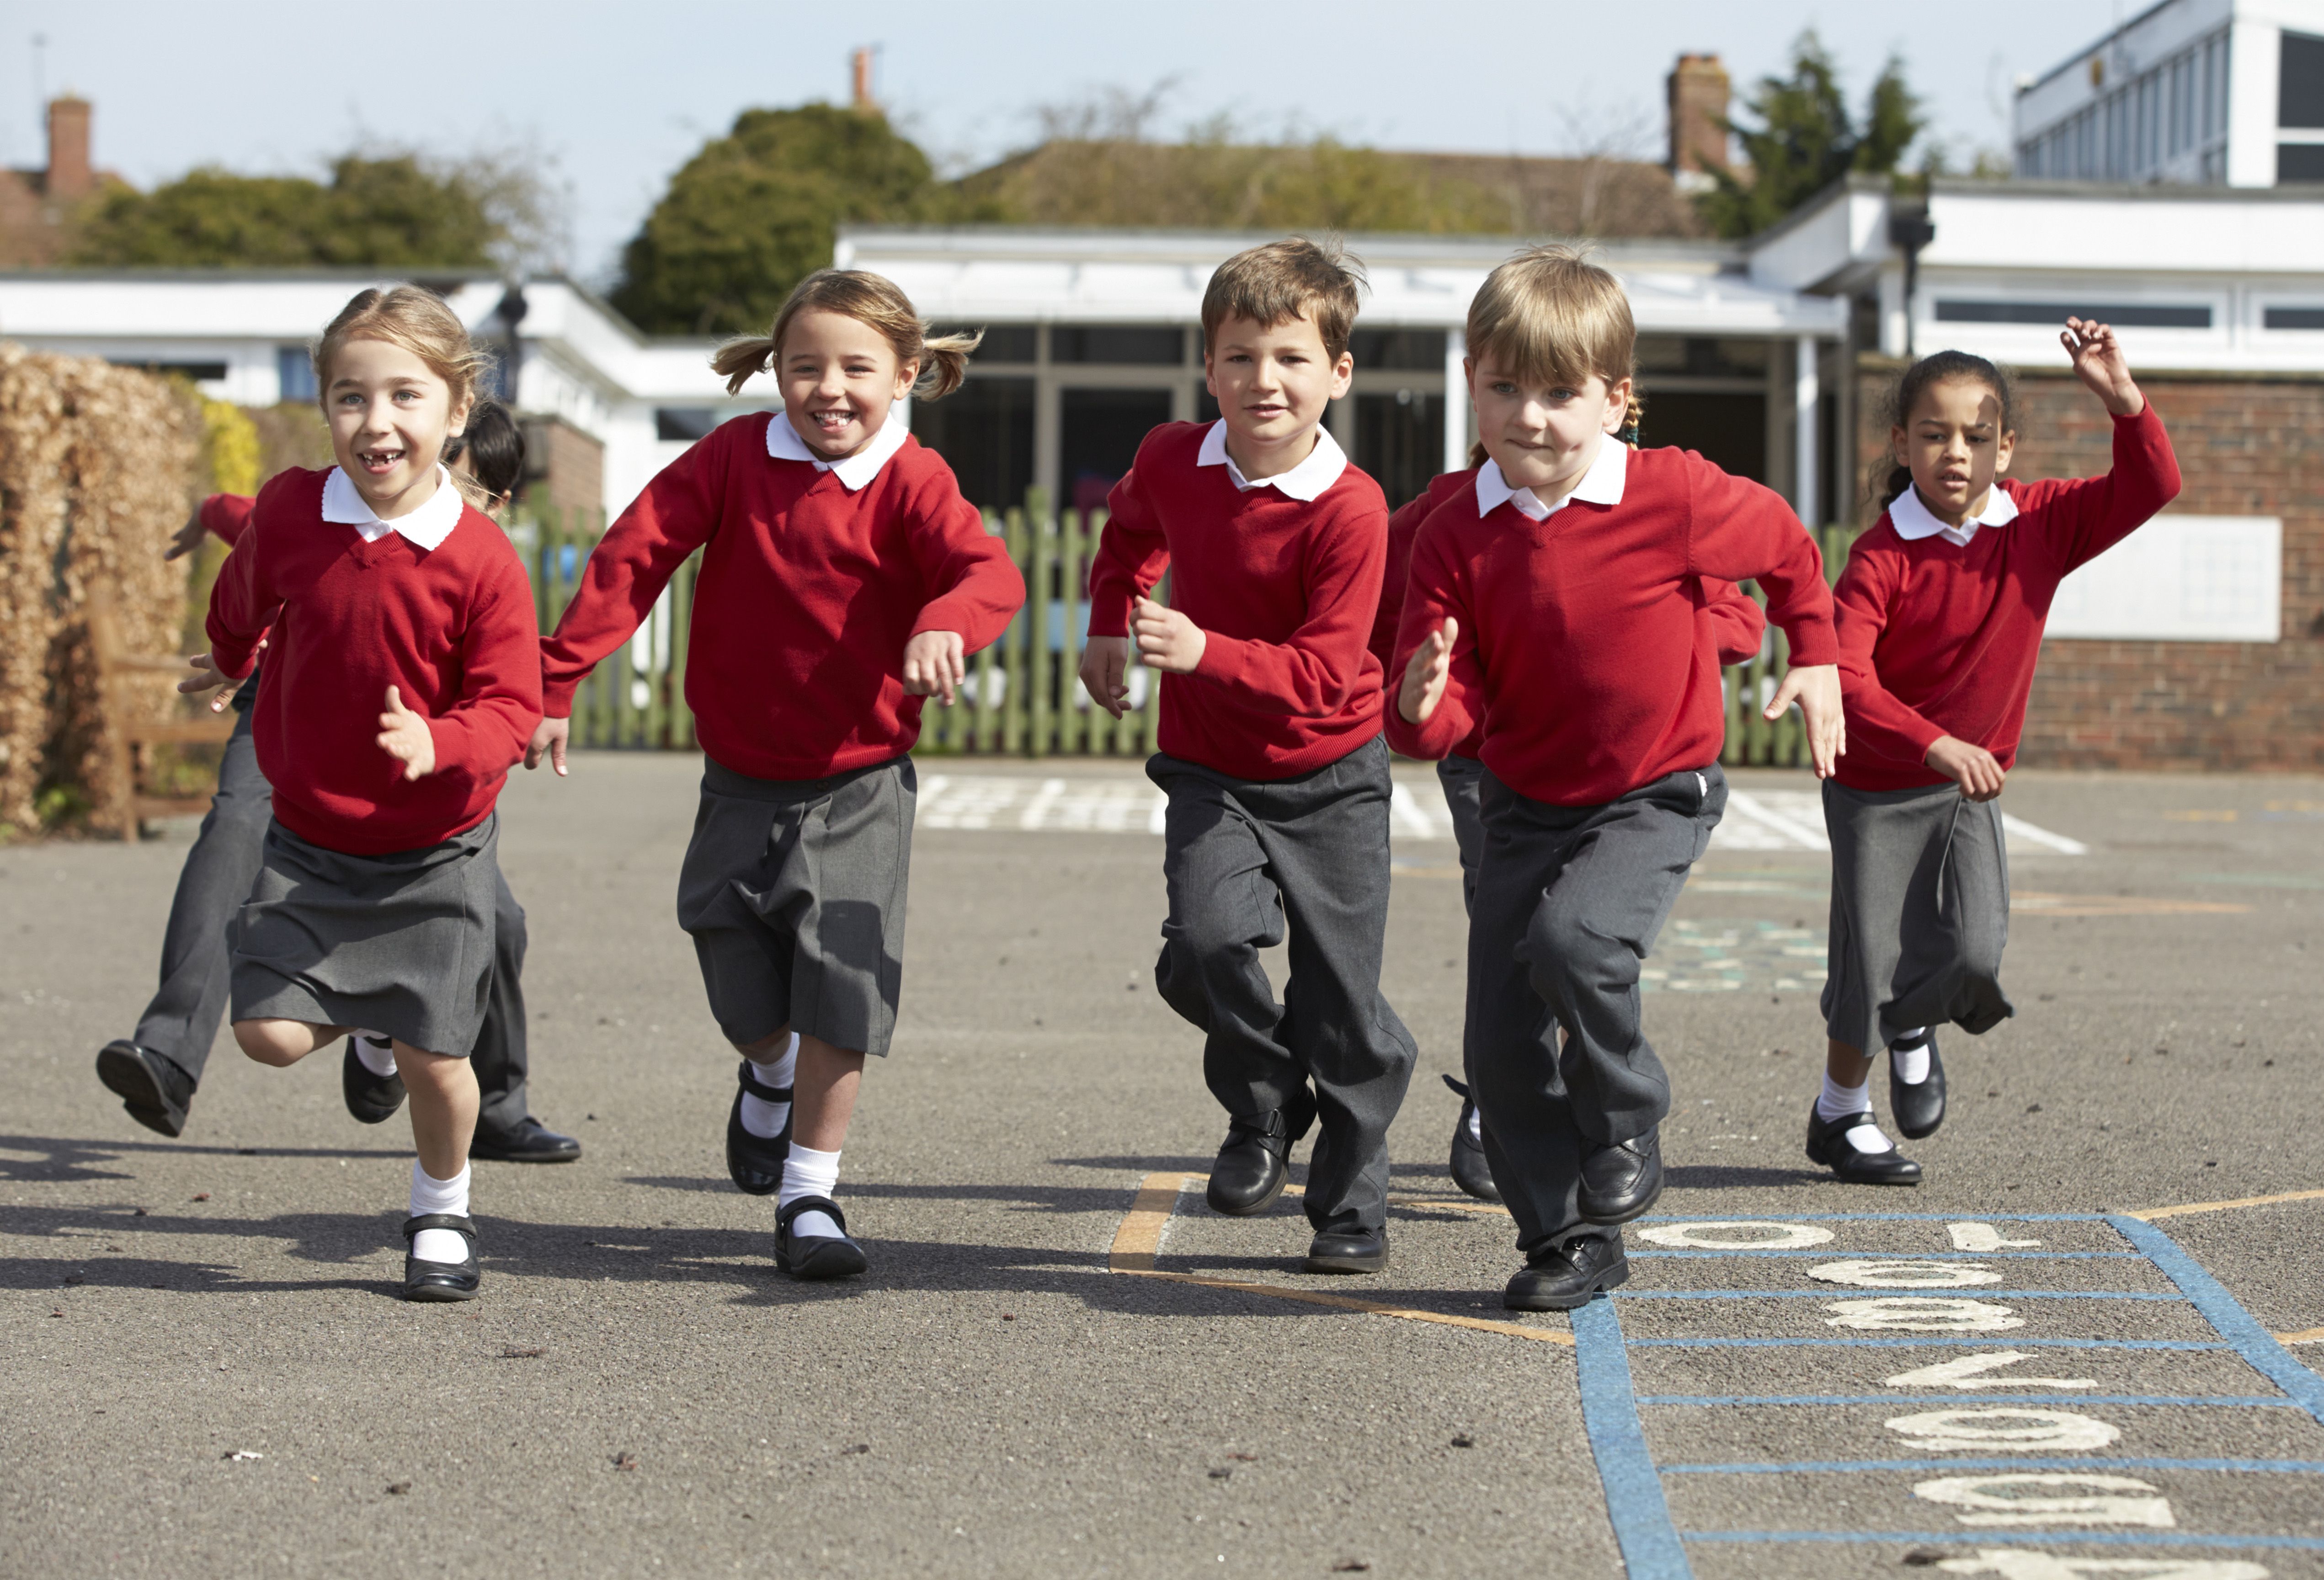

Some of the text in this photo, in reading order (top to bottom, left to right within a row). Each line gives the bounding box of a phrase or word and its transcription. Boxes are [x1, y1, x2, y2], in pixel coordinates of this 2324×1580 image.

[1636, 1220, 2042, 1252] 10
[1805, 1260, 2003, 1288] 9
[1823, 1297, 2025, 1331] 8
[1884, 1350, 2100, 1390] 7
[1883, 1408, 2121, 1452] 6
[1913, 1473, 2176, 1528] 5
